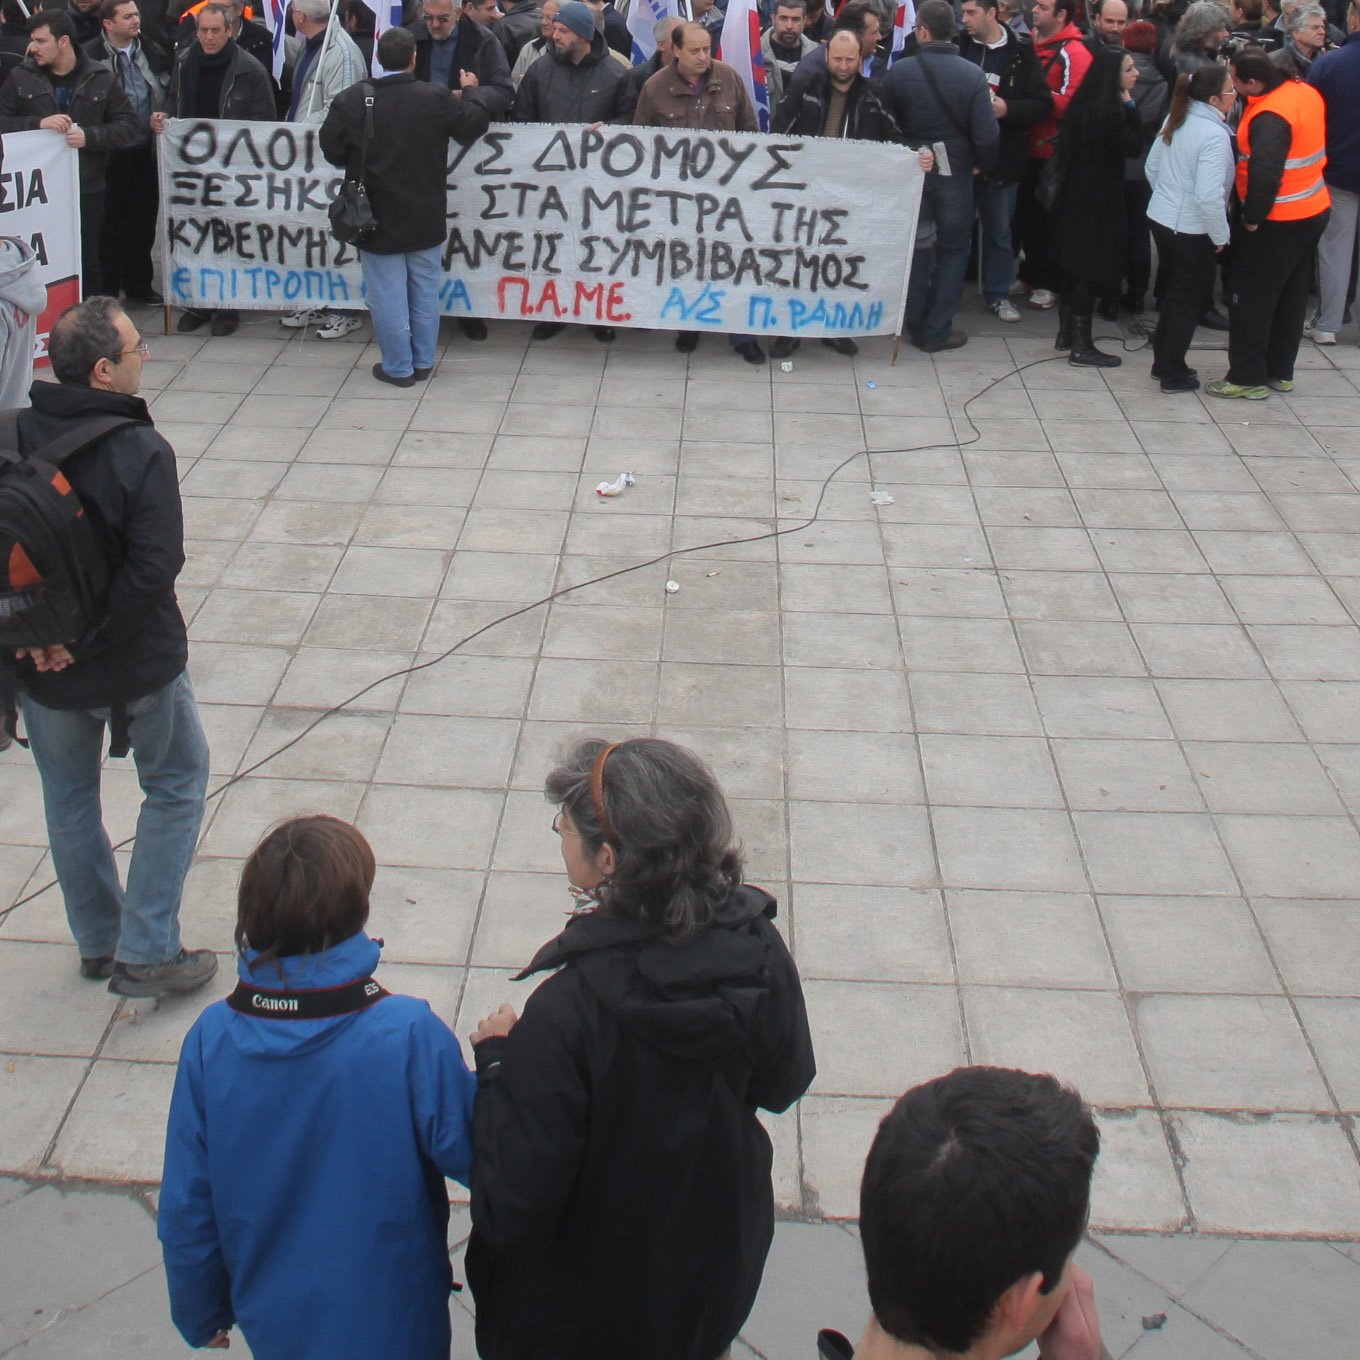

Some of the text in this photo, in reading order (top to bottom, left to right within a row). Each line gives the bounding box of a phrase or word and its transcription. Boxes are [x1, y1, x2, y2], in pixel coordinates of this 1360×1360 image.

[178, 122, 316, 173] ΟΛΟΙ
[533, 128, 807, 191] ΔΡΟΜΟΥΣ
[480, 182, 569, 222] ΣΤΑ
[581, 185, 754, 242] ΜΕΤΡΑ
[770, 201, 850, 246] ΤΗΣ
[172, 265, 350, 302] ΕΠΙΤΡΟΠΗ
[441, 228, 564, 273] ΑΝΕΙΣ
[578, 235, 869, 292] ΣΥΜΒΙΒΑΣΜΟΣ
[251, 982, 380, 1011] Canon EOS
